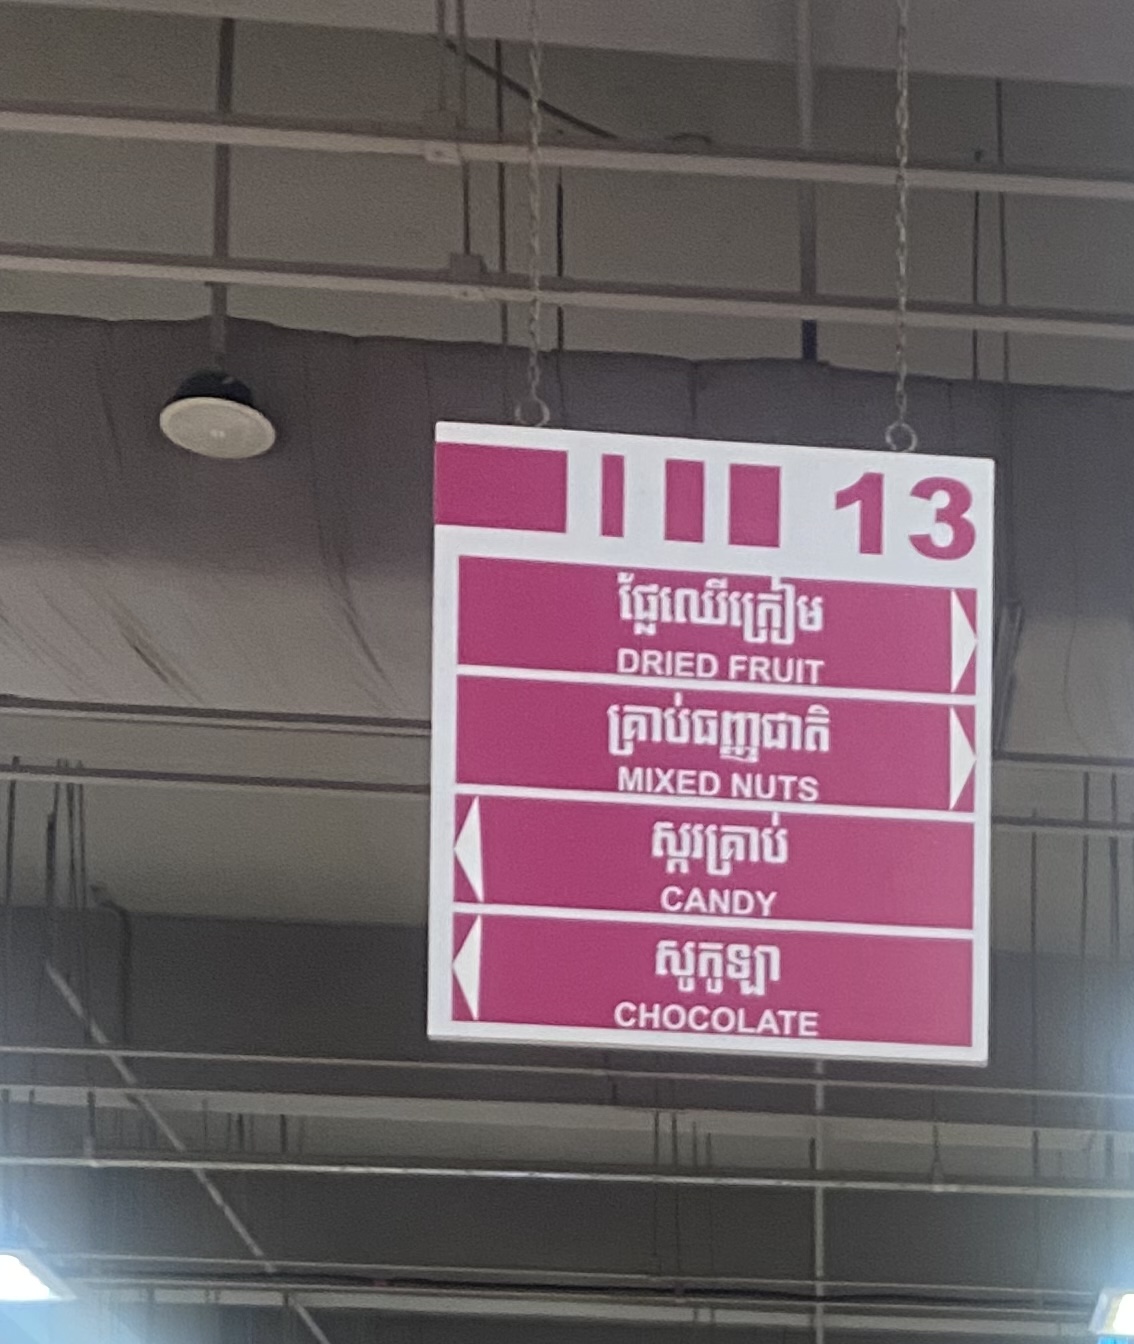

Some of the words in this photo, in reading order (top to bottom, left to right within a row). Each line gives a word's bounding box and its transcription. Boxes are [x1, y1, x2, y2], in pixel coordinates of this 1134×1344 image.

[834, 472, 977, 560] 13
[617, 648, 719, 679] DRIED
[728, 655, 825, 684] FRUIT
[618, 766, 721, 796] MIXED
[731, 772, 819, 802] NUTS
[652, 811, 788, 876] ស្ករគ្រាប់
[660, 886, 777, 917] CANDY
[655, 939, 781, 996] សូកូឡា
[614, 1001, 819, 1037] CHOCOLATE
